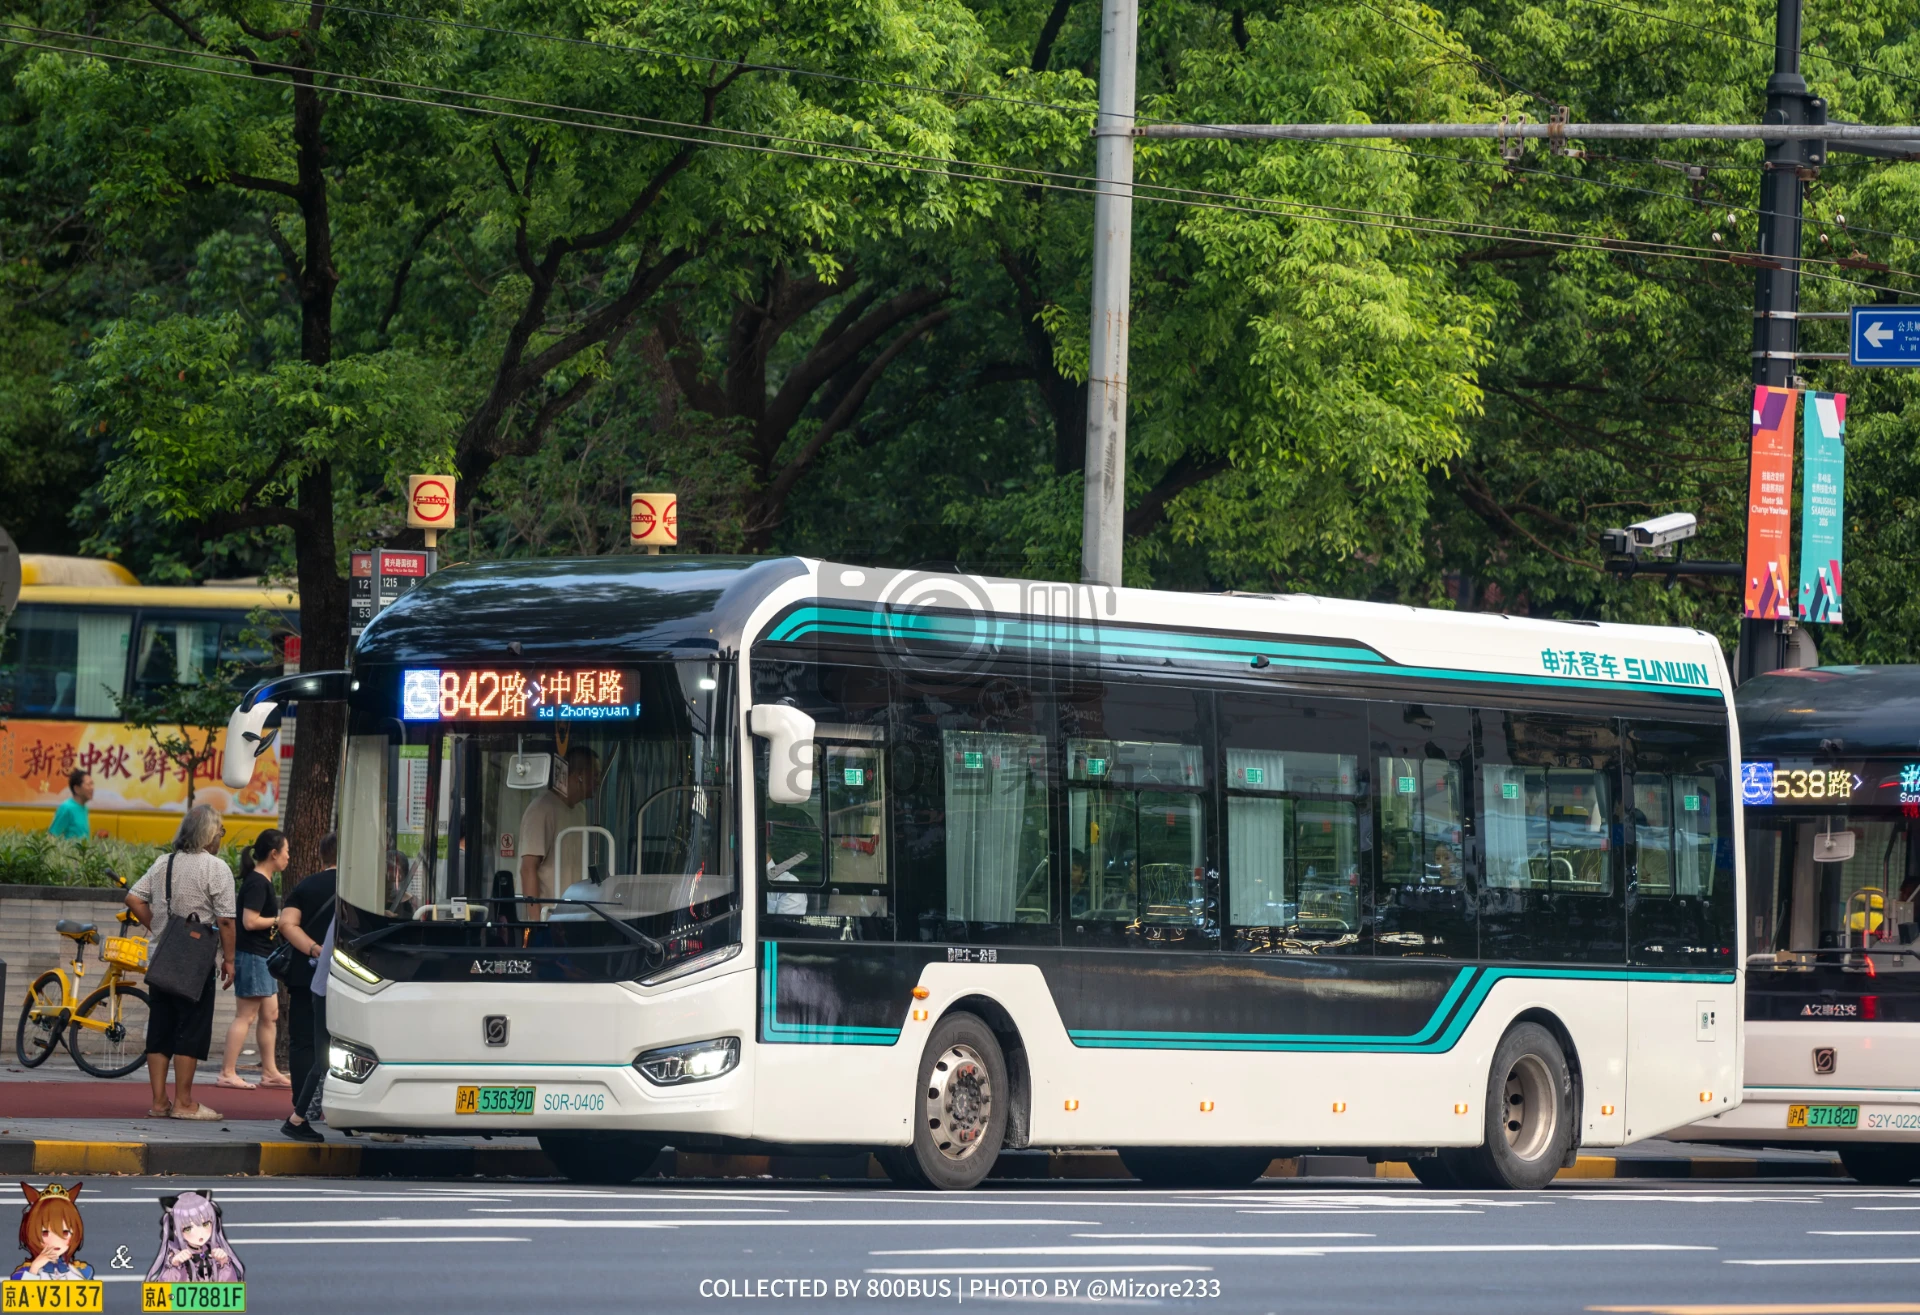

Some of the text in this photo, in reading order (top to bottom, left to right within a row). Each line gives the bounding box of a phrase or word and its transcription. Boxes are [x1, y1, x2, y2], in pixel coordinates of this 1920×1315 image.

[382, 578, 398, 587] 1215
[1541, 648, 1710, 686] 申沃客车 SUNWIN
[440, 671, 526, 718] 842路
[561, 704, 630, 718] Zhongyuan
[1772, 769, 1852, 798] 538路
